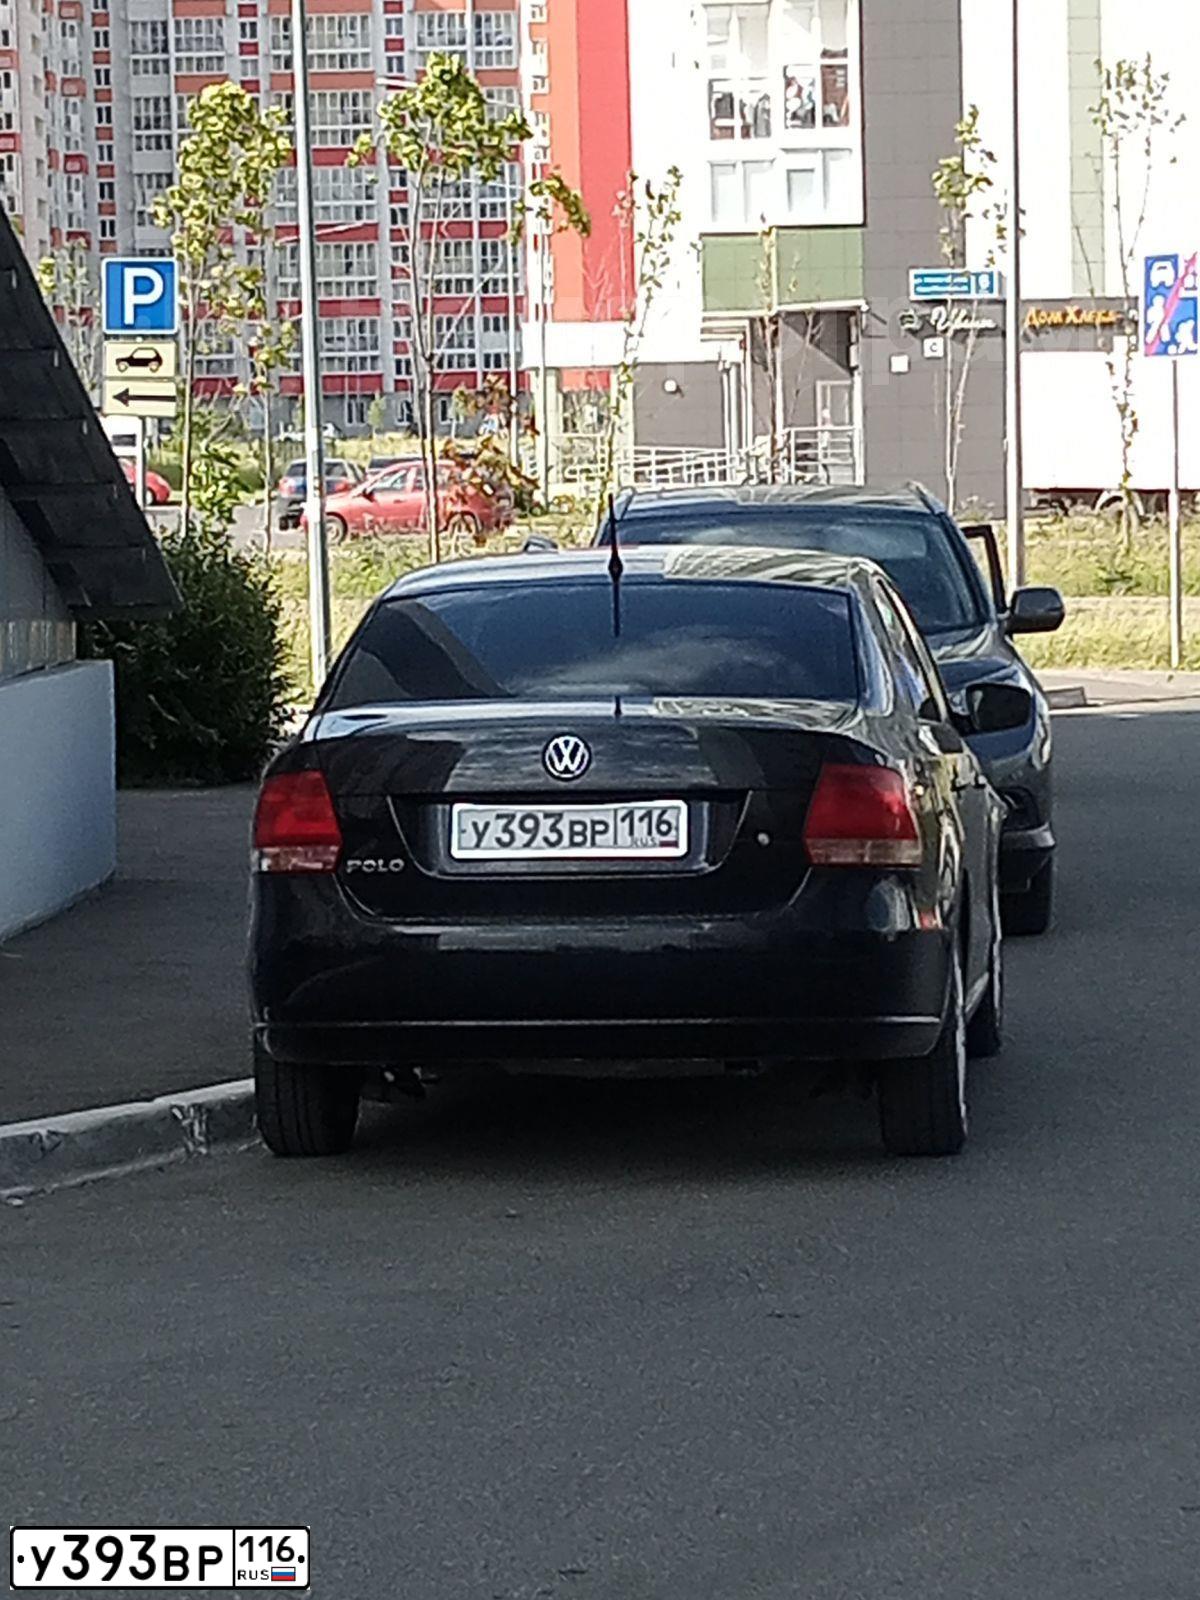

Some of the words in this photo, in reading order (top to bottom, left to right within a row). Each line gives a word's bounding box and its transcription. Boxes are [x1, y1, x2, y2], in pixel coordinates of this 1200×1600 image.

[124, 268, 164, 325] P
[620, 809, 673, 836] 116
[346, 859, 405, 873] POLO
